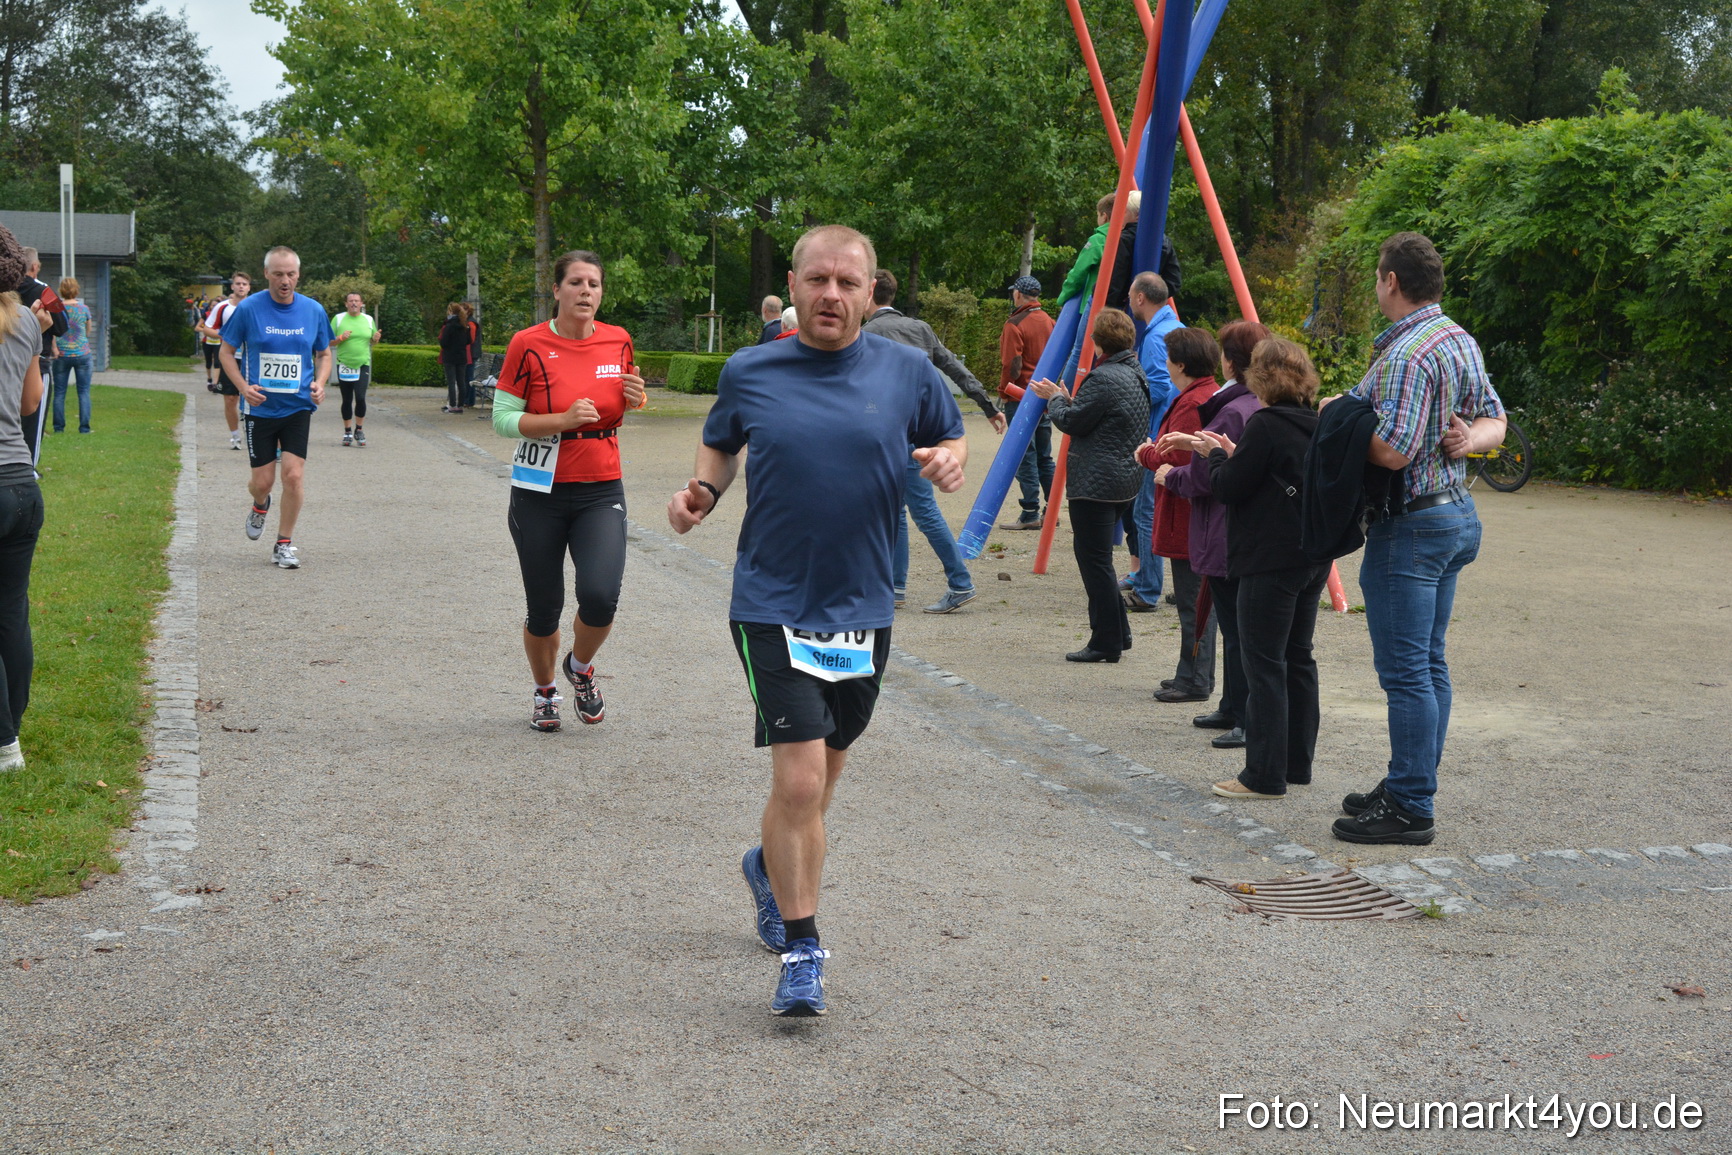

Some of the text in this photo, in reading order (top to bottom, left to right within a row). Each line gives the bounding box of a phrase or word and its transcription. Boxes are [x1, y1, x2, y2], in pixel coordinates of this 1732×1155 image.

[264, 363, 298, 379] 2709
[595, 364, 621, 375] JURA
[812, 651, 852, 669] Stefan
